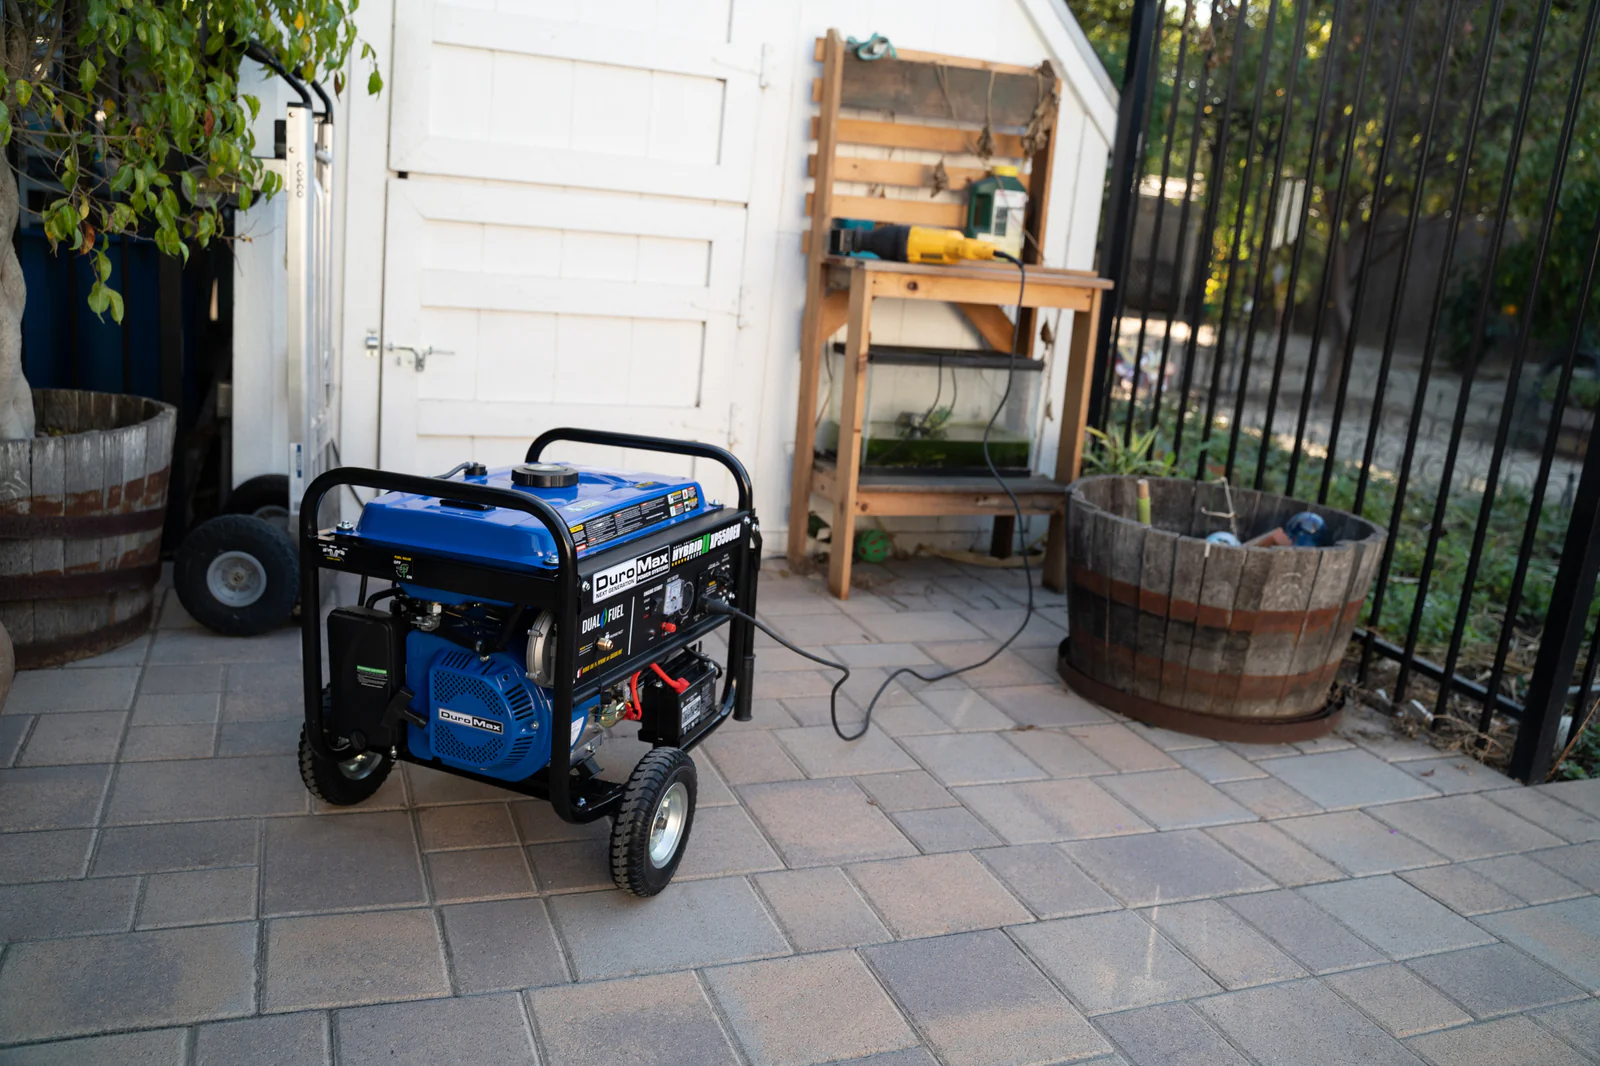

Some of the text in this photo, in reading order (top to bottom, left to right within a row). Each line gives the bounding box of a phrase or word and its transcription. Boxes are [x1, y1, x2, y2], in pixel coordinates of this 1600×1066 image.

[672, 539, 703, 562] HYBRID
[596, 553, 669, 592] DuroMax
[596, 590, 608, 599] NEXT
[608, 578, 635, 595] GENERATION
[582, 613, 601, 635] DUAL
[607, 603, 625, 623] FUEL
[441, 710, 501, 732] DuroMax
